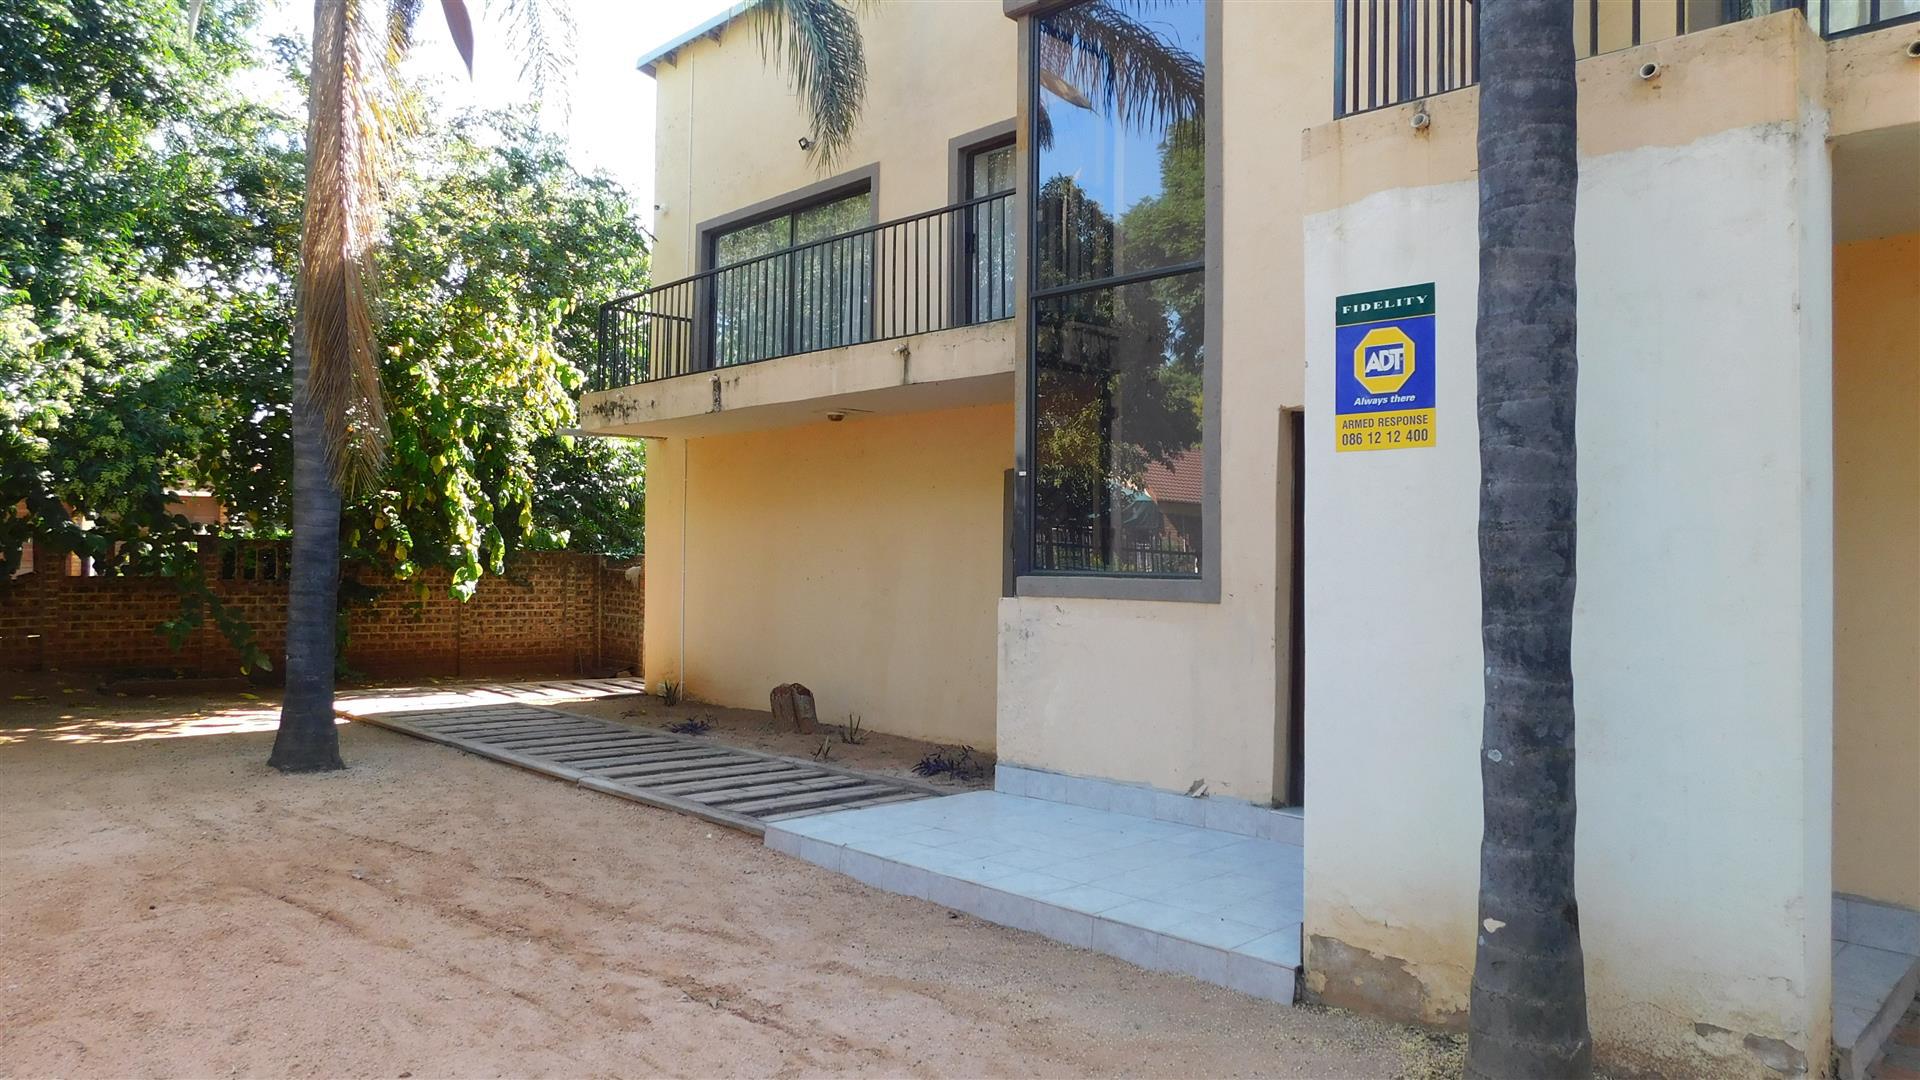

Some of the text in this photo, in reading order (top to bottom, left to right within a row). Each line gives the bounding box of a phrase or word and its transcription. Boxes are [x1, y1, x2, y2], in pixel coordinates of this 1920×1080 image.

[1342, 295, 1428, 314] FIDELITY
[1365, 348, 1404, 374] ADT
[1354, 394, 1416, 407] Always there
[1342, 414, 1428, 430] ARMED RESPONSE
[1342, 428, 1428, 446] 086 12 12 400
